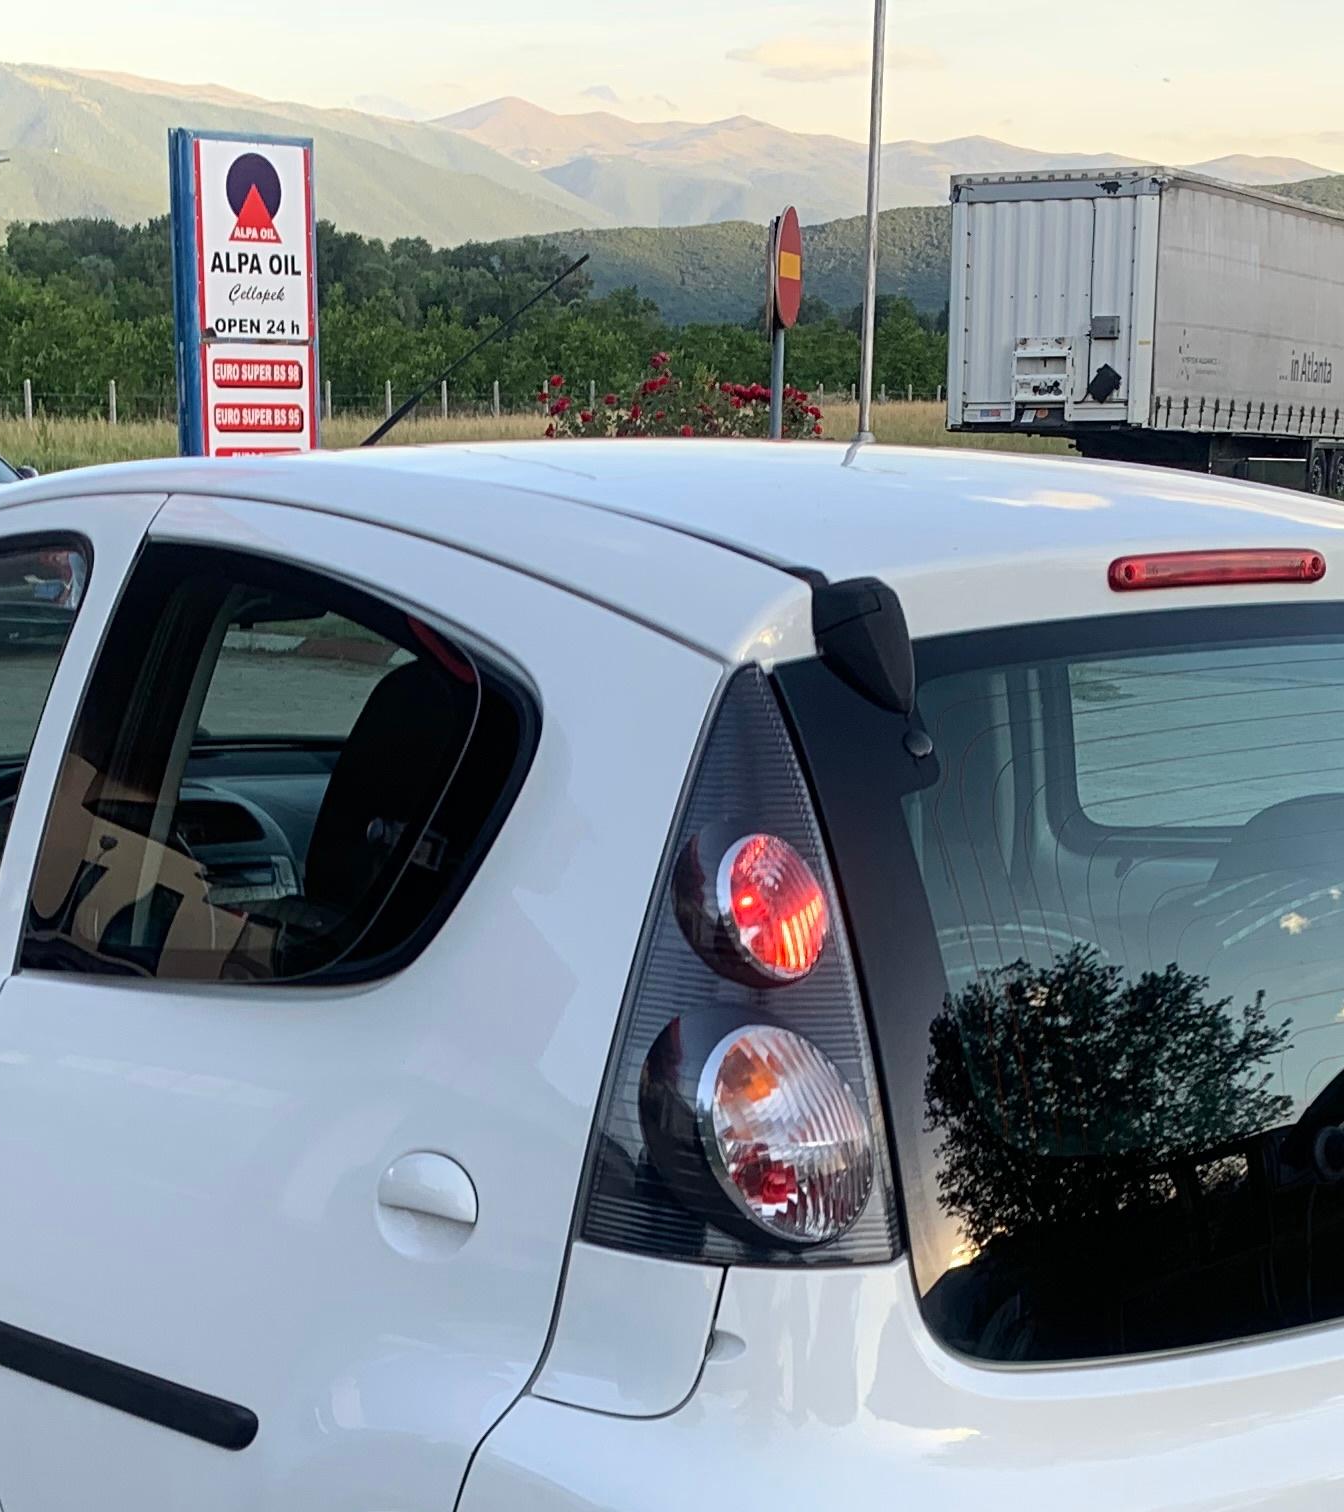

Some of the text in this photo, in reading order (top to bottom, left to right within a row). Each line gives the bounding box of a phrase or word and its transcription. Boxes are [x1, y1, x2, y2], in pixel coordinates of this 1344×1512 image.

[234, 226, 277, 240] ALPA OIL
[210, 251, 301, 276] ALPA OIL
[215, 317, 300, 335] OPEN 24 h
[214, 363, 300, 382] EURO SUPER BS 98
[1290, 349, 1299, 382] in
[1299, 351, 1332, 383] Atlanta
[215, 407, 300, 426] EURO SUPER BS 95
